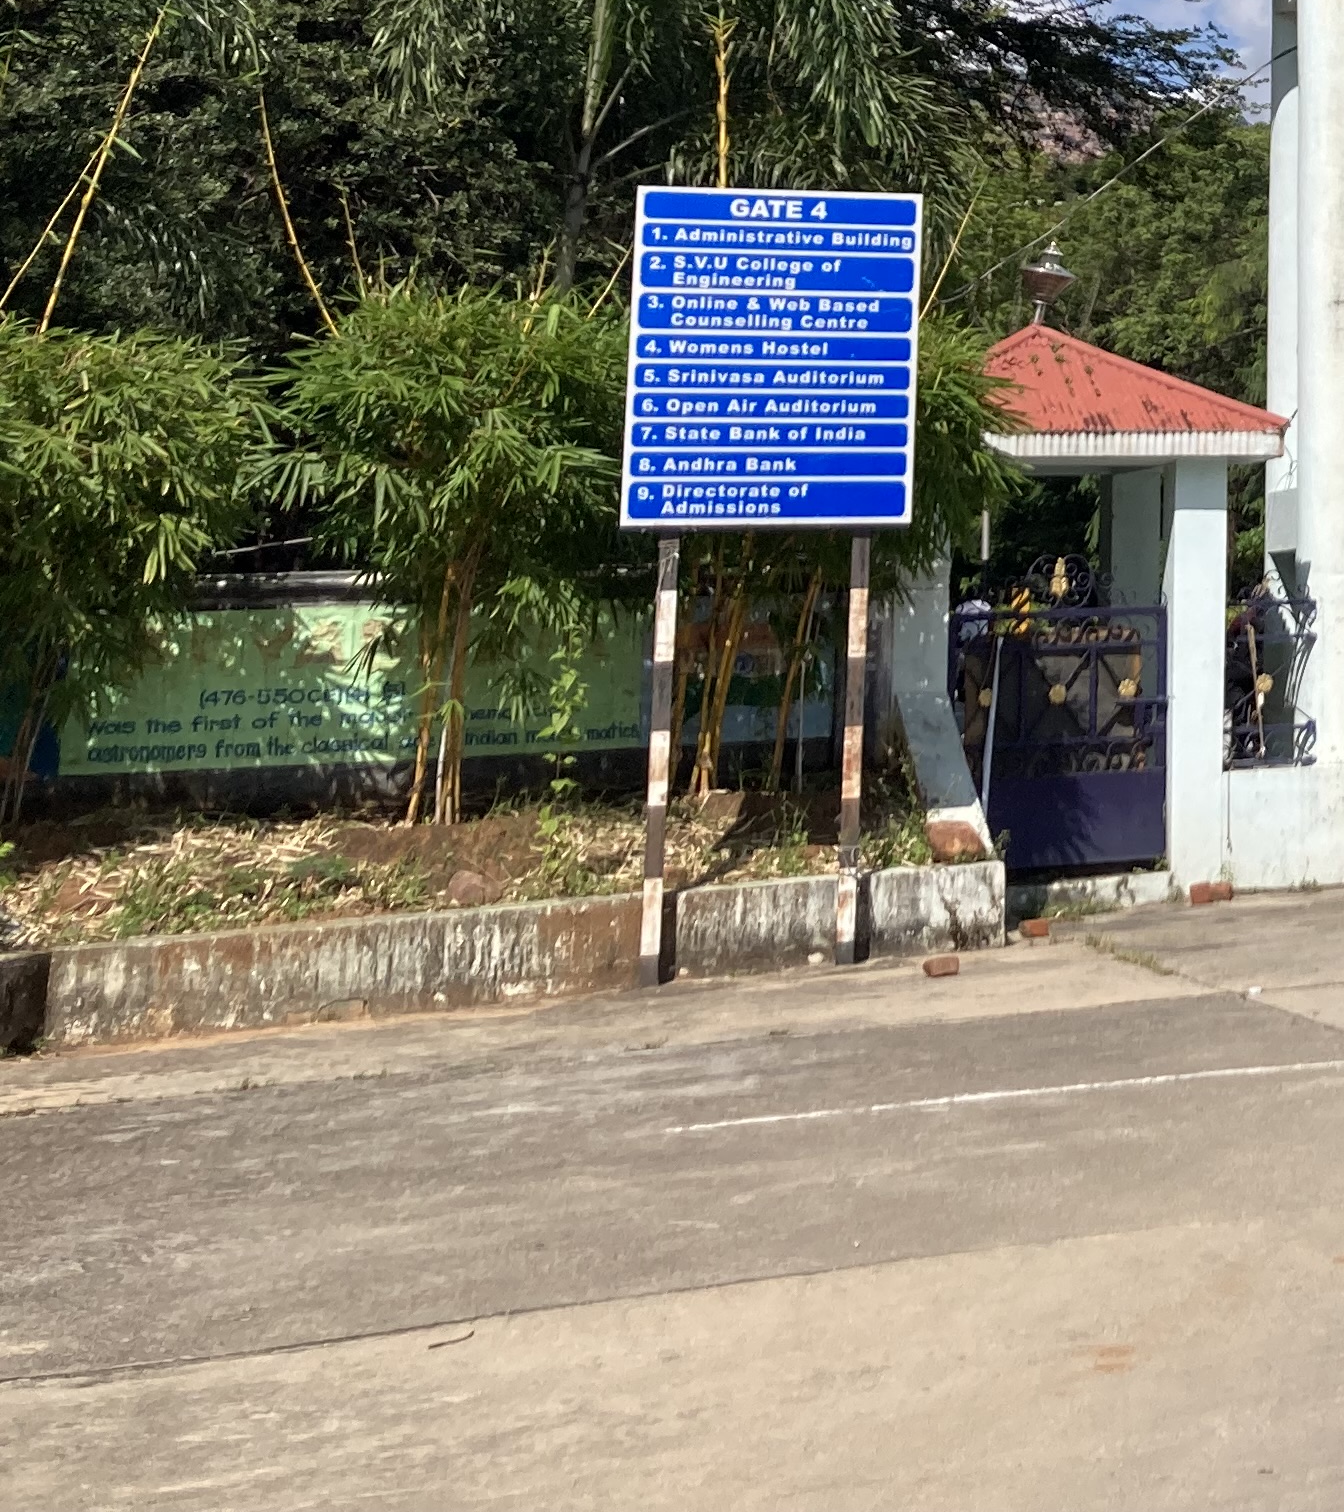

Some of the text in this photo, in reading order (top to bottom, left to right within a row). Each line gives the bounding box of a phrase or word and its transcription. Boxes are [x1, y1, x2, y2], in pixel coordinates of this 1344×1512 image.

[730, 198, 828, 220] GATE 4
[652, 227, 912, 250] 1. Administrative Building
[650, 255, 841, 274] 2. S.V.U College of
[673, 271, 796, 289] Engineering
[648, 295, 880, 313] 3. Online & Web Based
[671, 313, 868, 330] Counselling Centre
[644, 339, 828, 356] 4. Womens Hostel
[643, 369, 884, 385] 5. Srinivasa Auditorium
[641, 398, 877, 415] 6. Open Air Auditorium
[640, 426, 866, 441] 7. State Bank of India
[638, 457, 796, 472] 8. Andhra Bank
[637, 484, 808, 501] 9. Directorate of
[660, 500, 781, 515] Admissions
[191, 713, 242, 732] first
[252, 713, 280, 729] of
[215, 739, 260, 758] from
